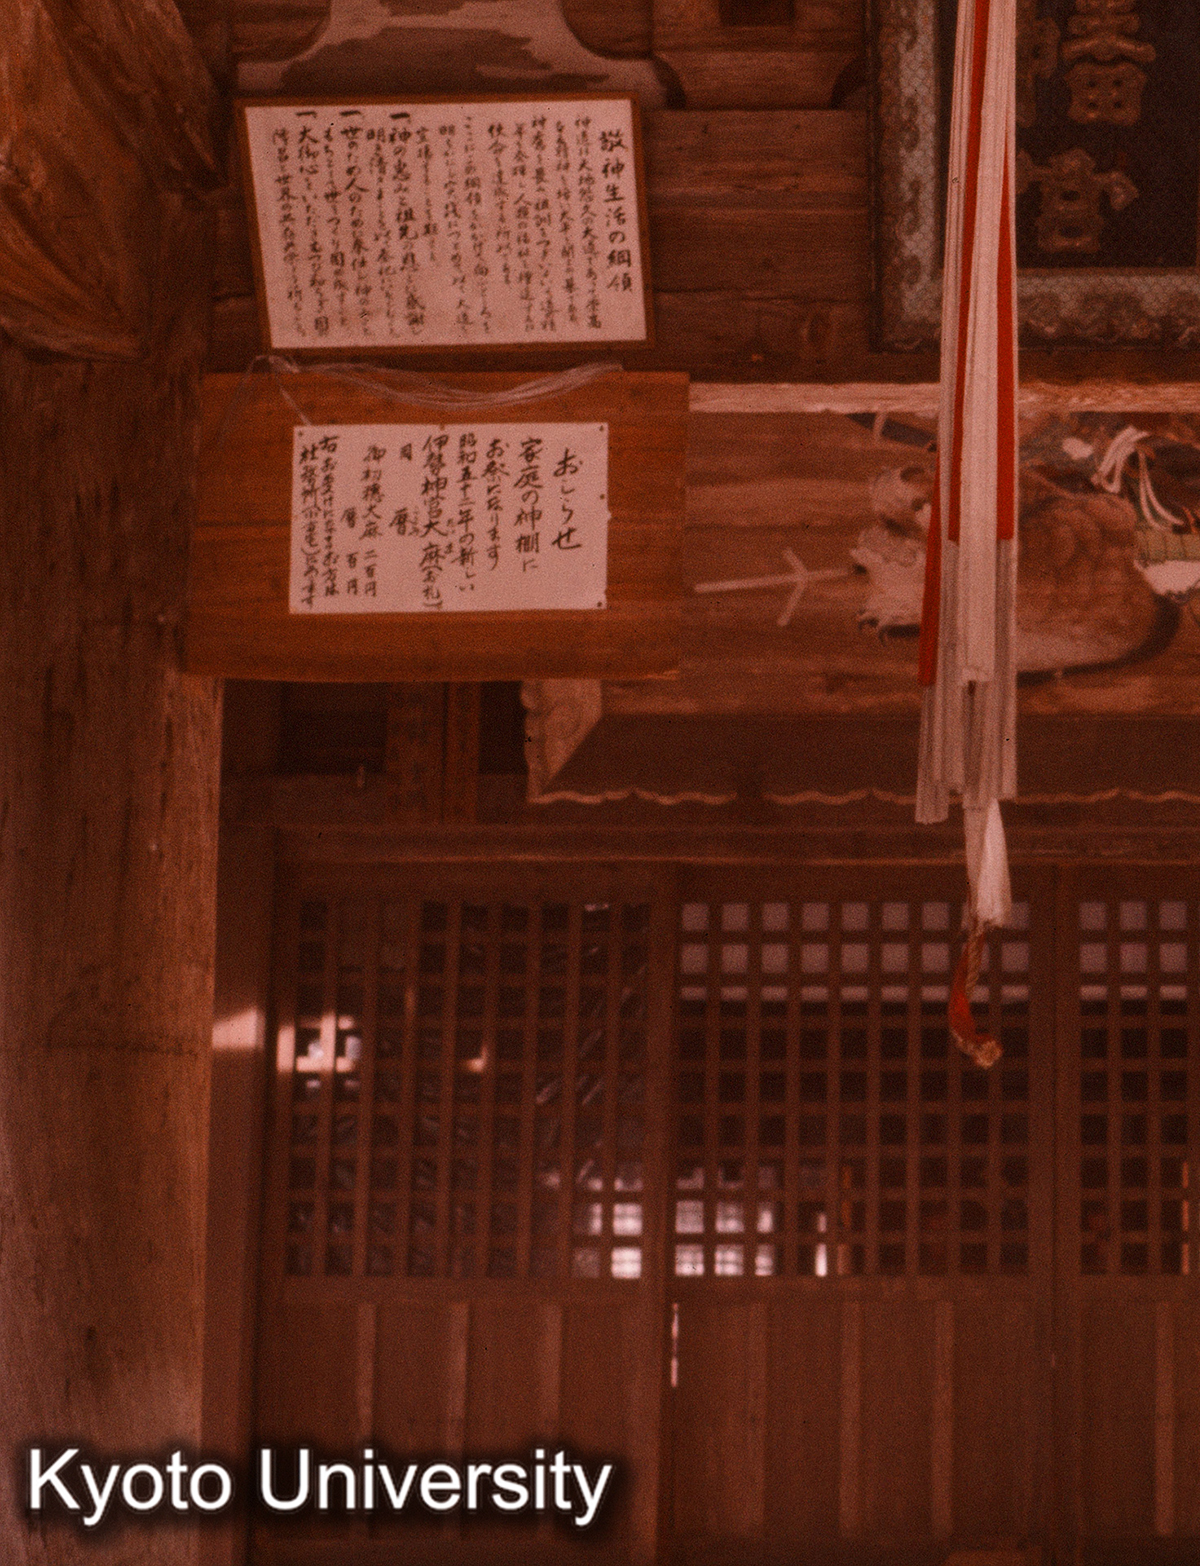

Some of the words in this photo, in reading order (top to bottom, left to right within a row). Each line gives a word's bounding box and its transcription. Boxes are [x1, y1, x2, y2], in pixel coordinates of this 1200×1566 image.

[599, 130, 633, 294] 敬神生活の綱領
[513, 436, 549, 573] 家庭の神棚に
[551, 447, 584, 551] おしらせ
